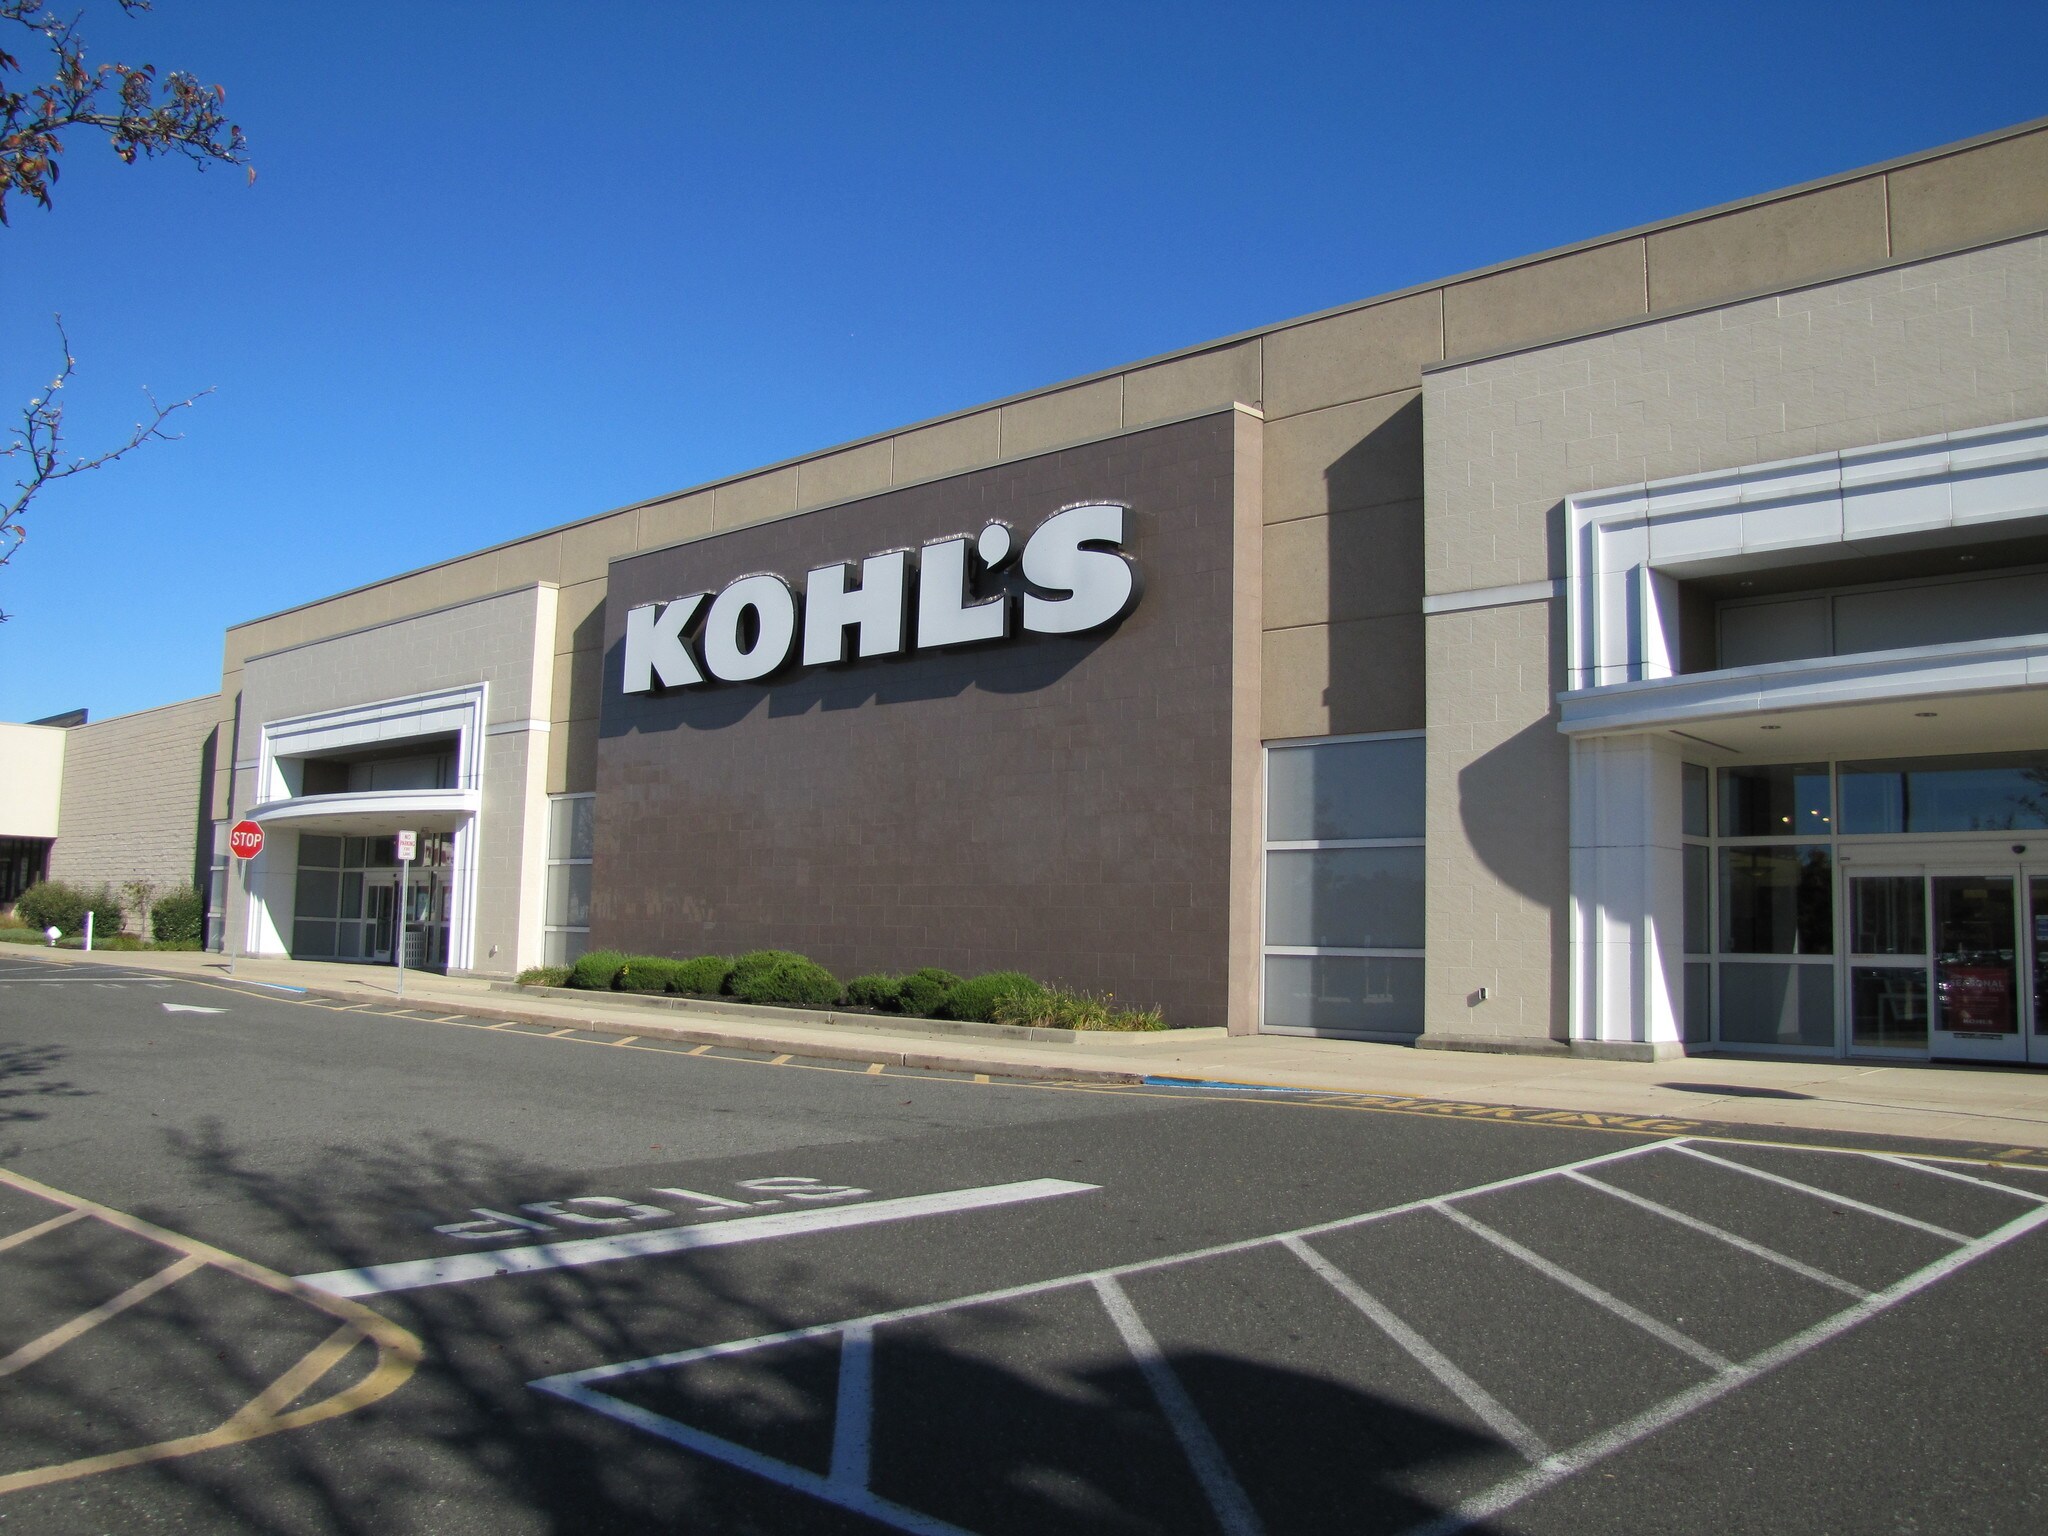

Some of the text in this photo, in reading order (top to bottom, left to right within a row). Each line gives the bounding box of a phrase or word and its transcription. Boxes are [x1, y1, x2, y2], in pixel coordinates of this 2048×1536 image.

[623, 503, 1135, 695] KOHL'S
[232, 831, 262, 848] STOP
[433, 1176, 872, 1238] STOP
